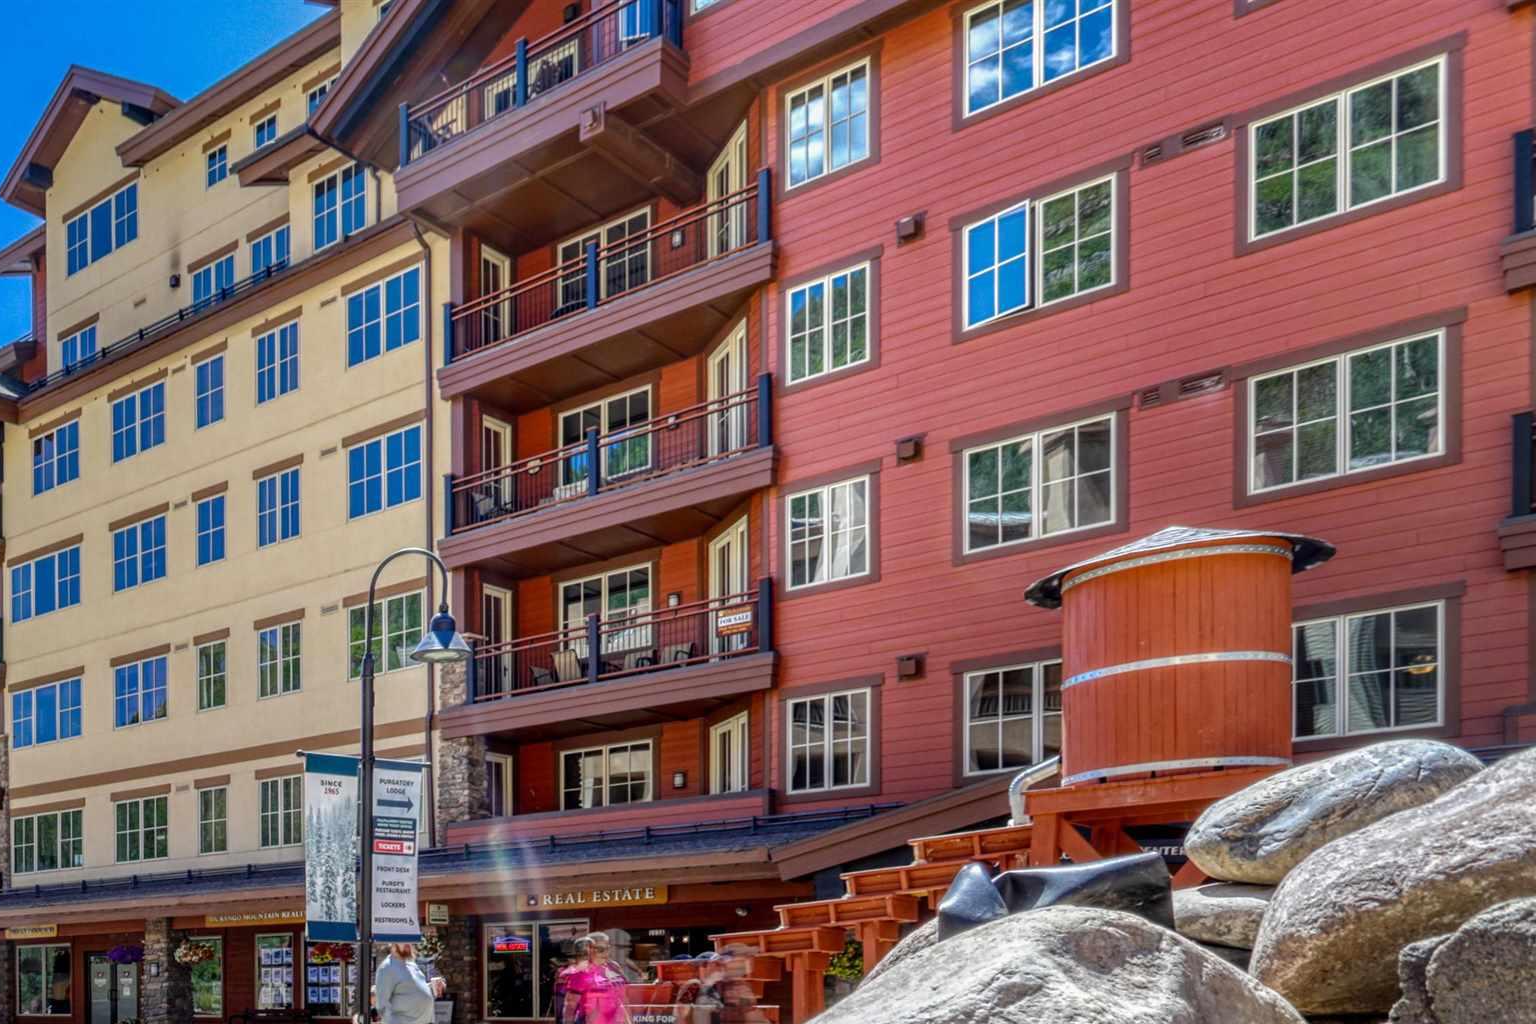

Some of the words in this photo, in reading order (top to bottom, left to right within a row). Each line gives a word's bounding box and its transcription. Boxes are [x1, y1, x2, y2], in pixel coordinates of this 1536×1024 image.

[320, 779, 343, 787] SINCE
[379, 778, 415, 787] PURGATORY
[386, 787, 406, 795] LODGE
[544, 892, 586, 905] REAL
[592, 887, 655, 902] ESTATE
